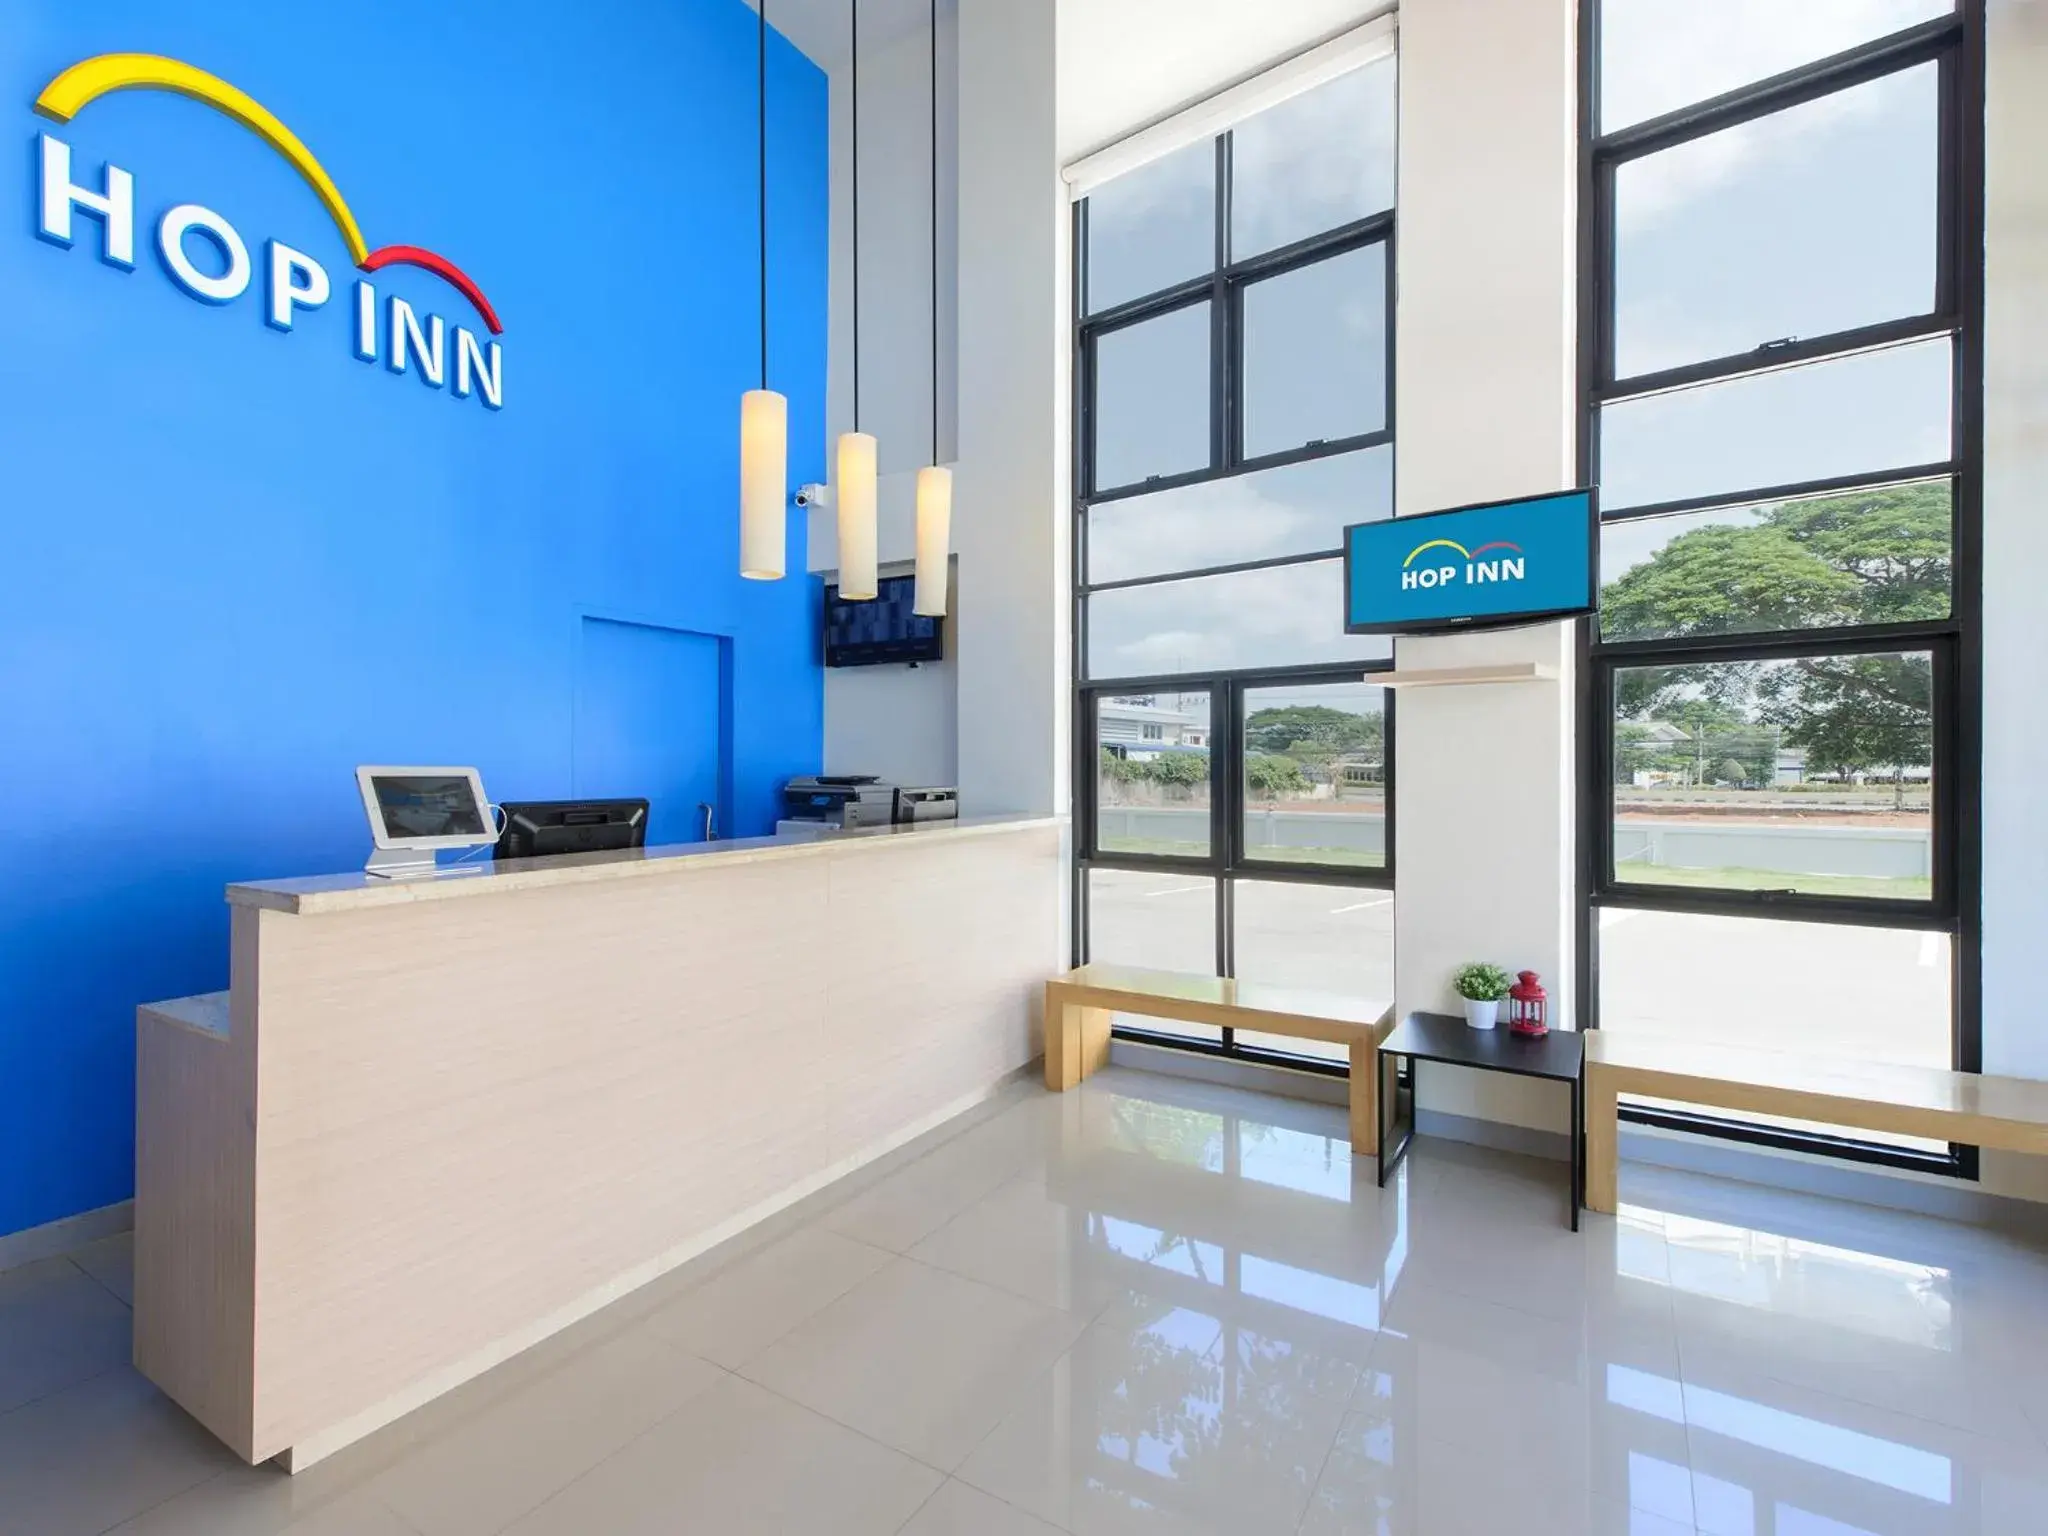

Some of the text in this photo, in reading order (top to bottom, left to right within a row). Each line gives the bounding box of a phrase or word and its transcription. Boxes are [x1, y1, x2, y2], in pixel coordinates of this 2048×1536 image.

[40, 133, 503, 408] HOP INN
[1401, 557, 1525, 590] HOP INN
